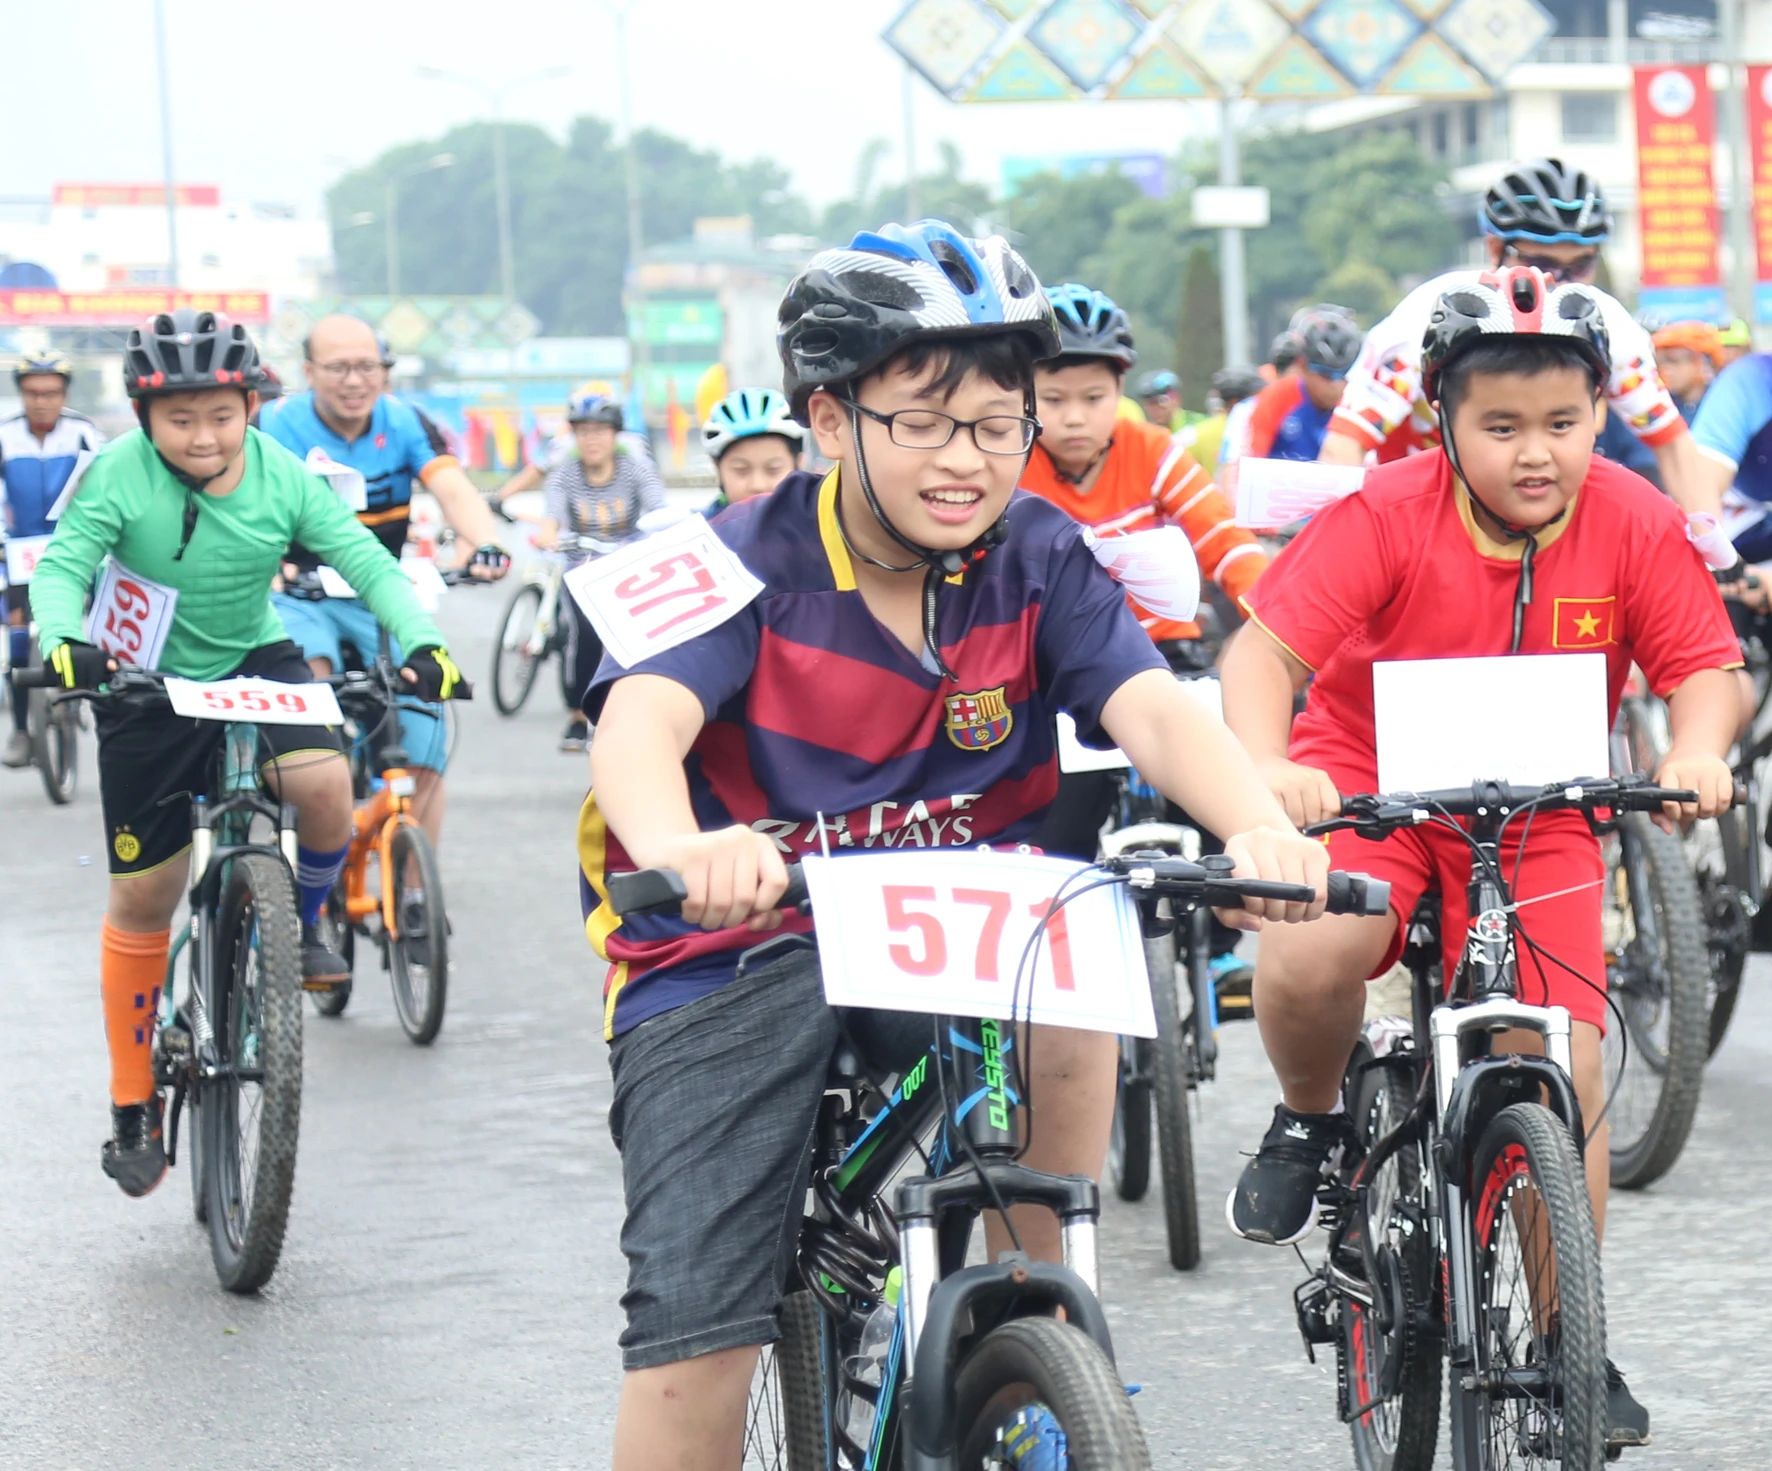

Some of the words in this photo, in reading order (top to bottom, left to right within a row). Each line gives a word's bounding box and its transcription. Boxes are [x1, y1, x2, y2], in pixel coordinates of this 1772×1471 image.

[614, 552, 729, 640] 571
[203, 690, 307, 713] 559
[881, 884, 1077, 992] 571
[902, 1055, 928, 1101] 007
